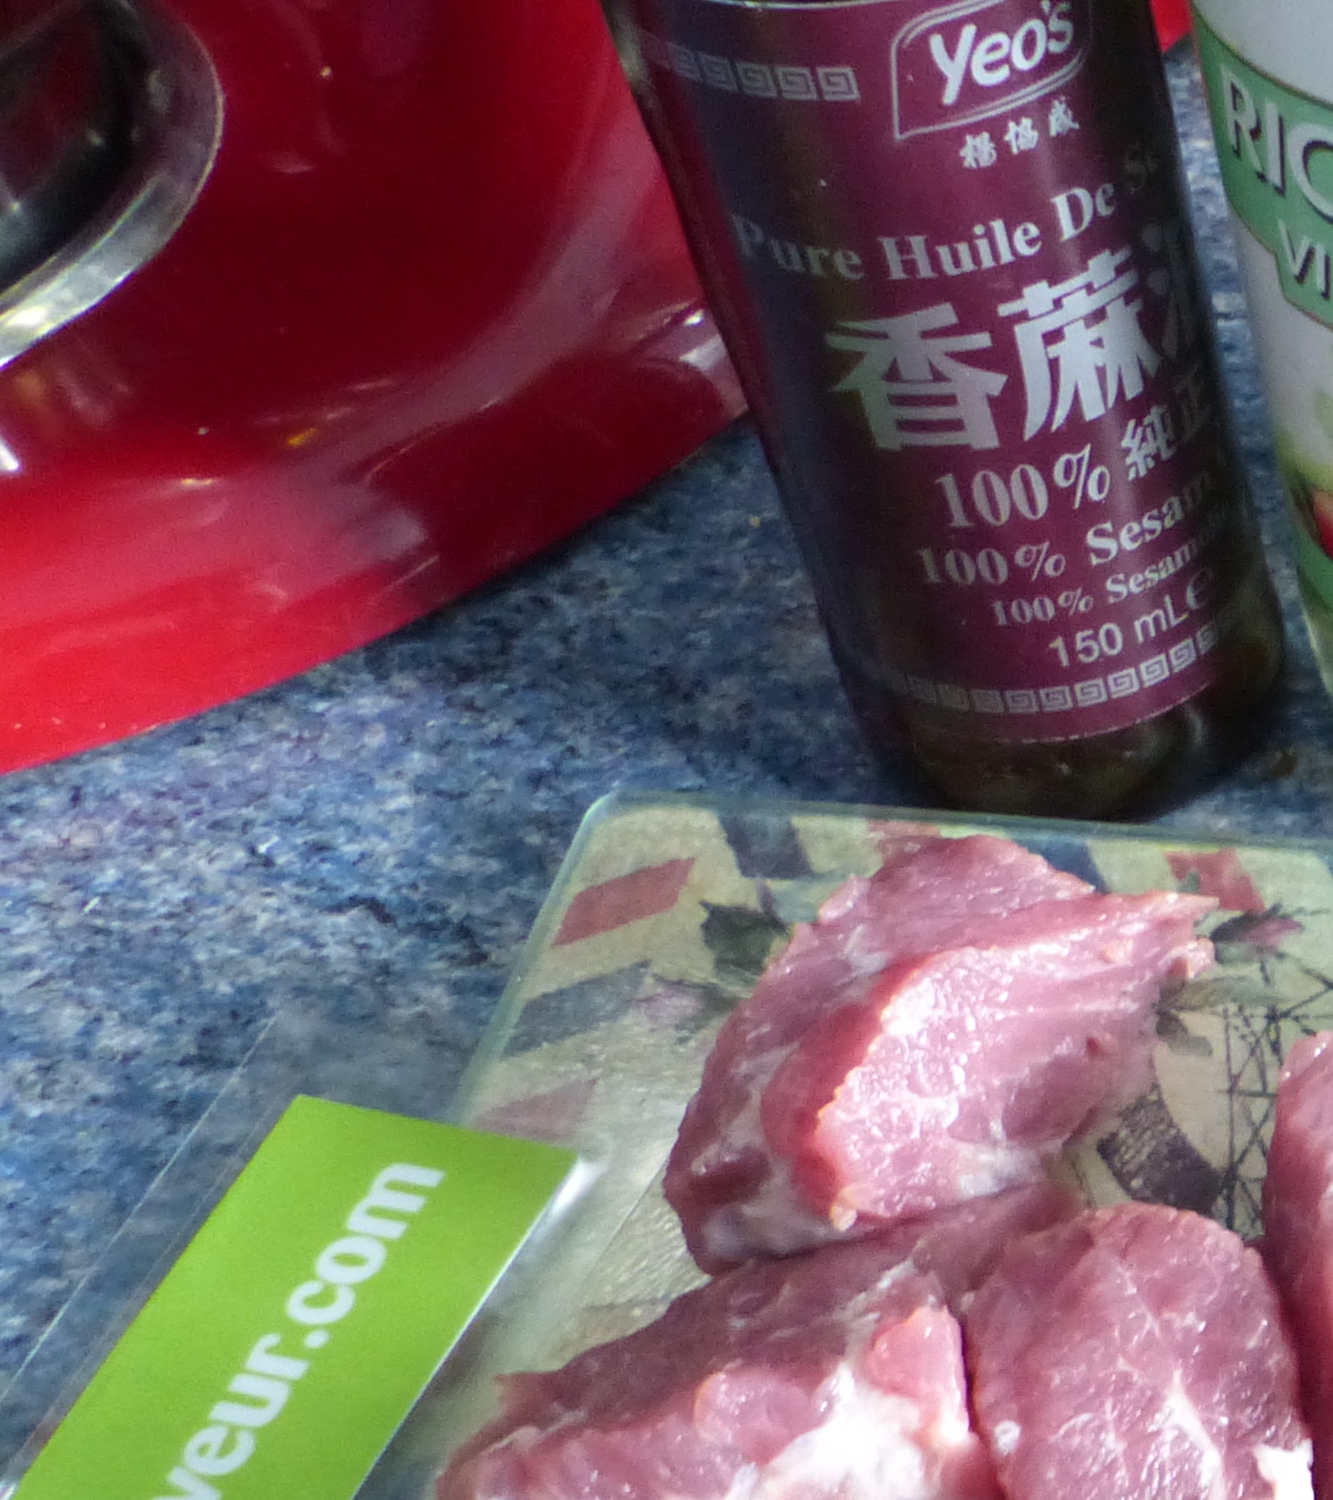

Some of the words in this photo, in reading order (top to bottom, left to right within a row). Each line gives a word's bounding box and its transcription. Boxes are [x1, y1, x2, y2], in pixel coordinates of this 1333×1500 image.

[928, 0, 1074, 105] Yeo's
[729, 211, 866, 281] Pure
[877, 215, 1042, 281] Huile
[1051, 182, 1116, 243] De
[1049, 622, 1124, 669] 150
